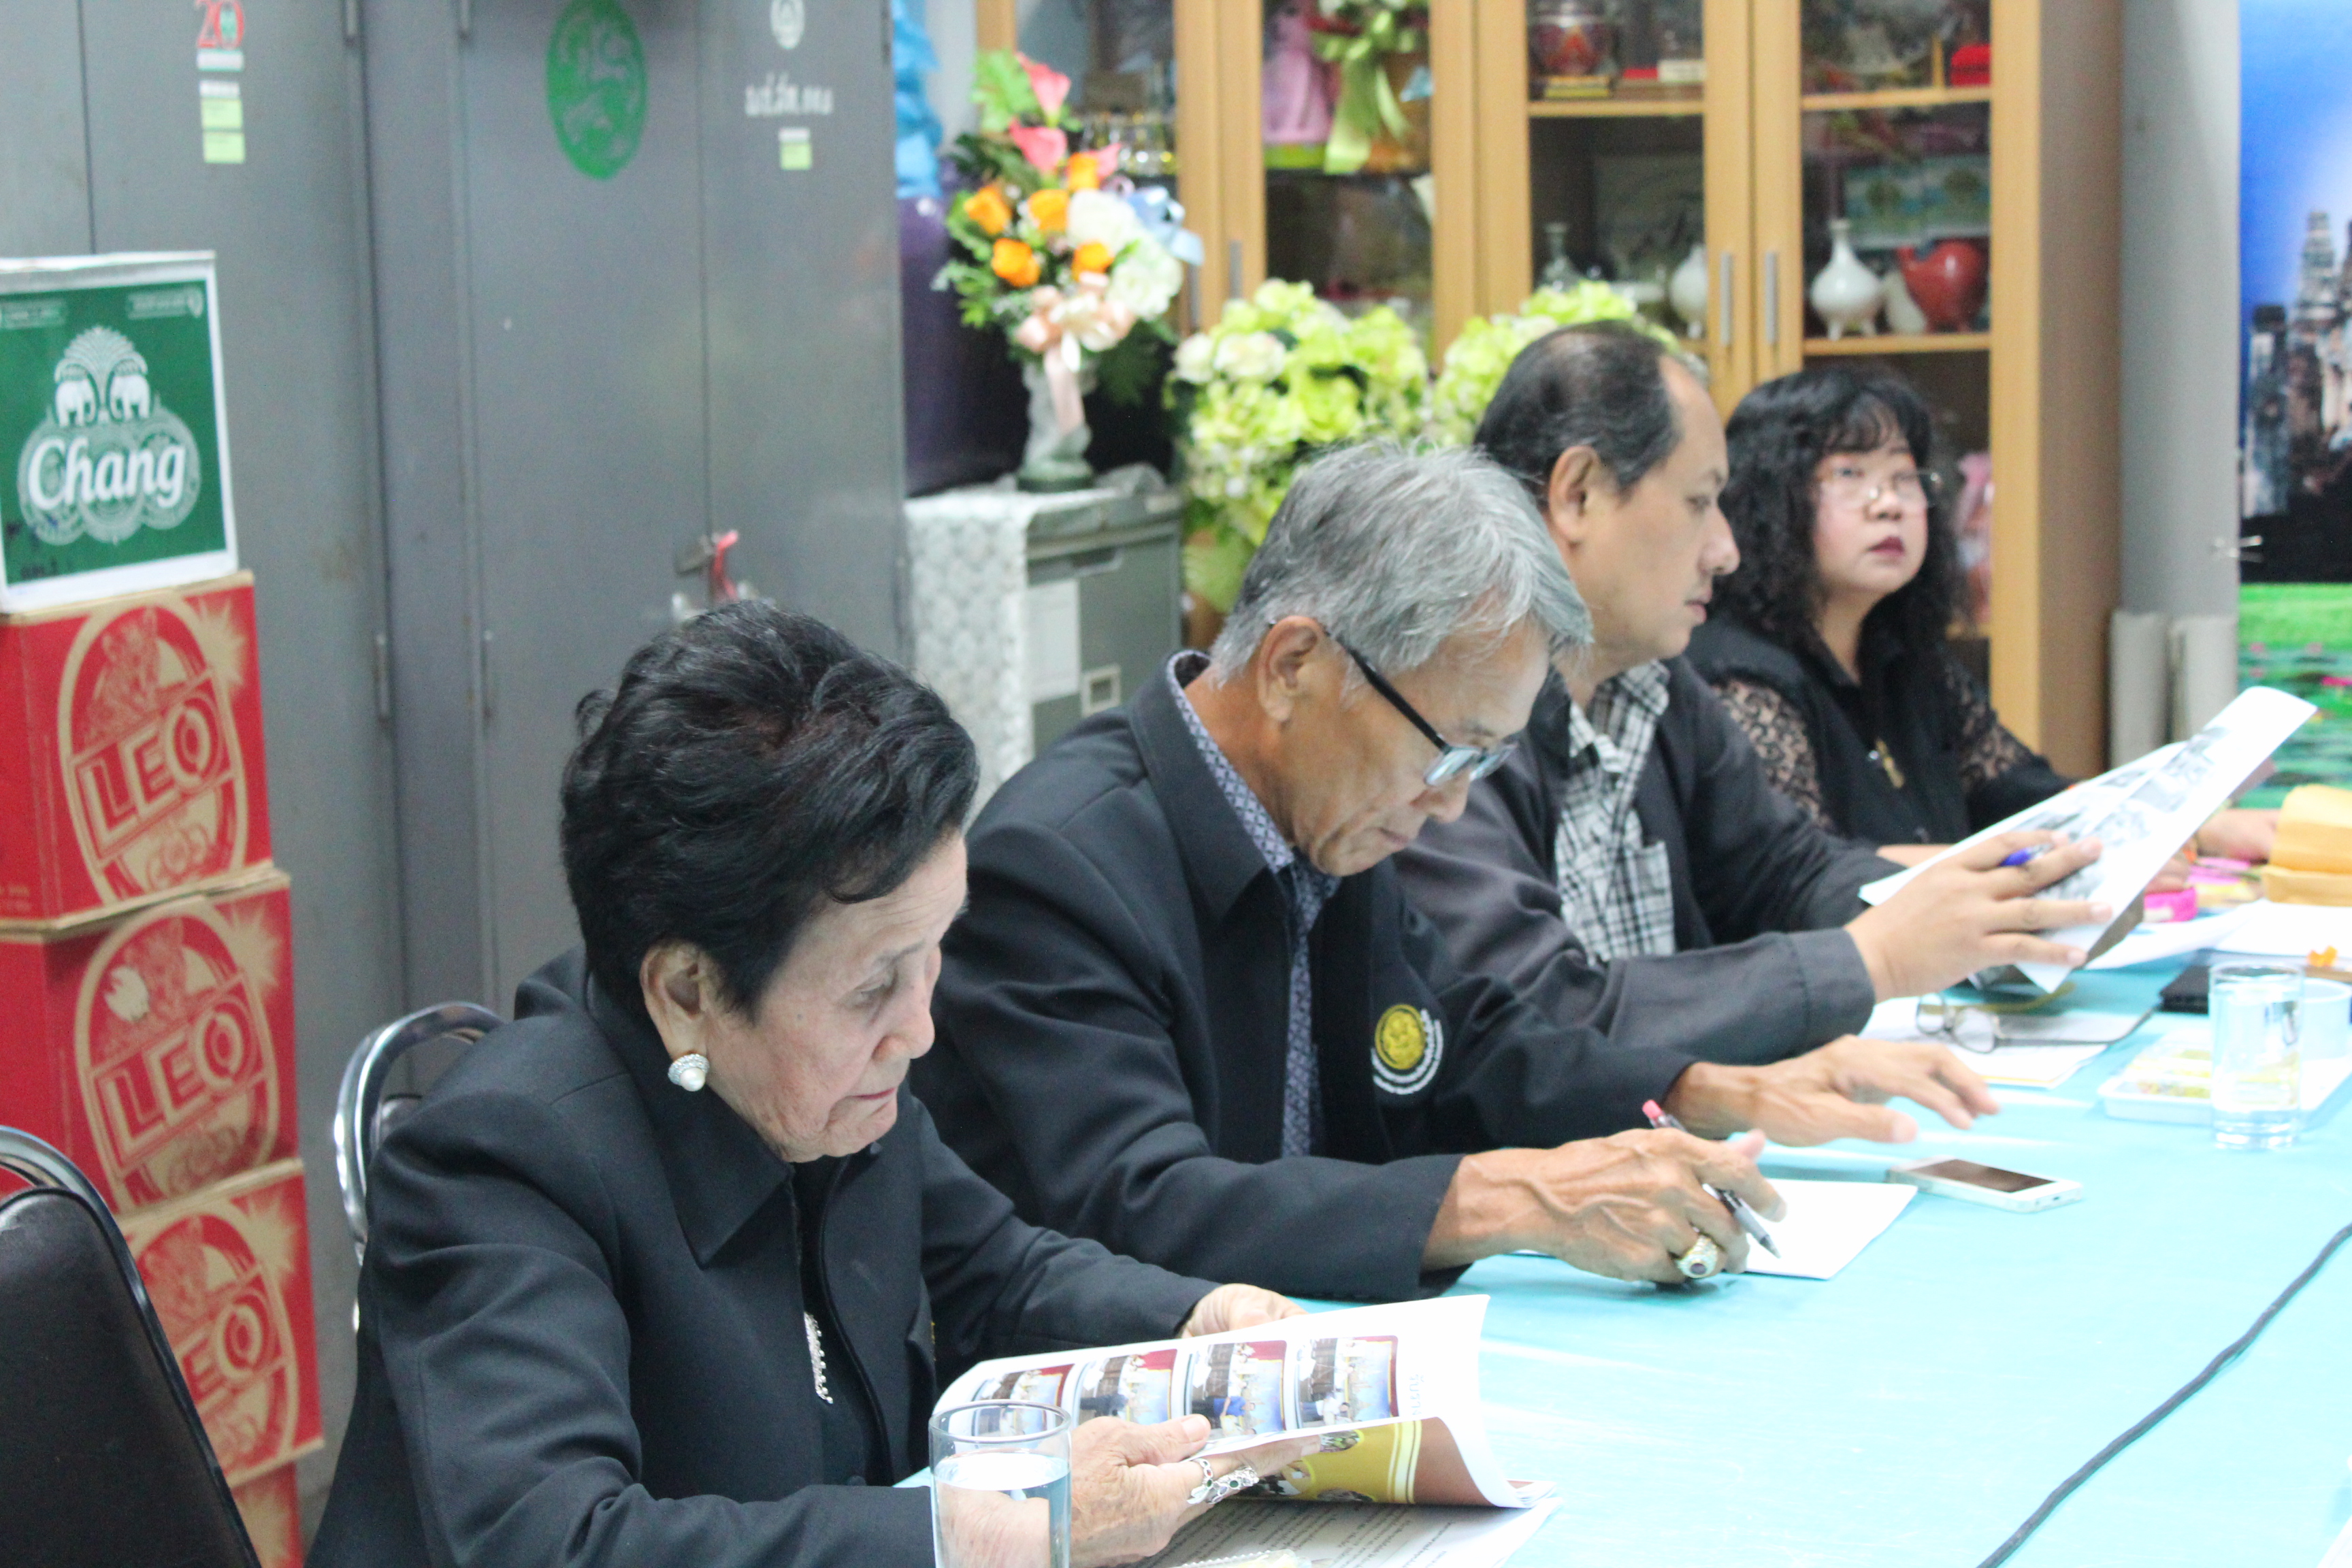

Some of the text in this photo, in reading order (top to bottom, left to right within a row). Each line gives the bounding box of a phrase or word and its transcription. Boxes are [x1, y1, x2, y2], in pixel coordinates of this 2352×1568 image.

[28, 436, 187, 510] Chang
[79, 701, 215, 847] LEO
[97, 1000, 249, 1155] LEO
[173, 1296, 267, 1414] EO
